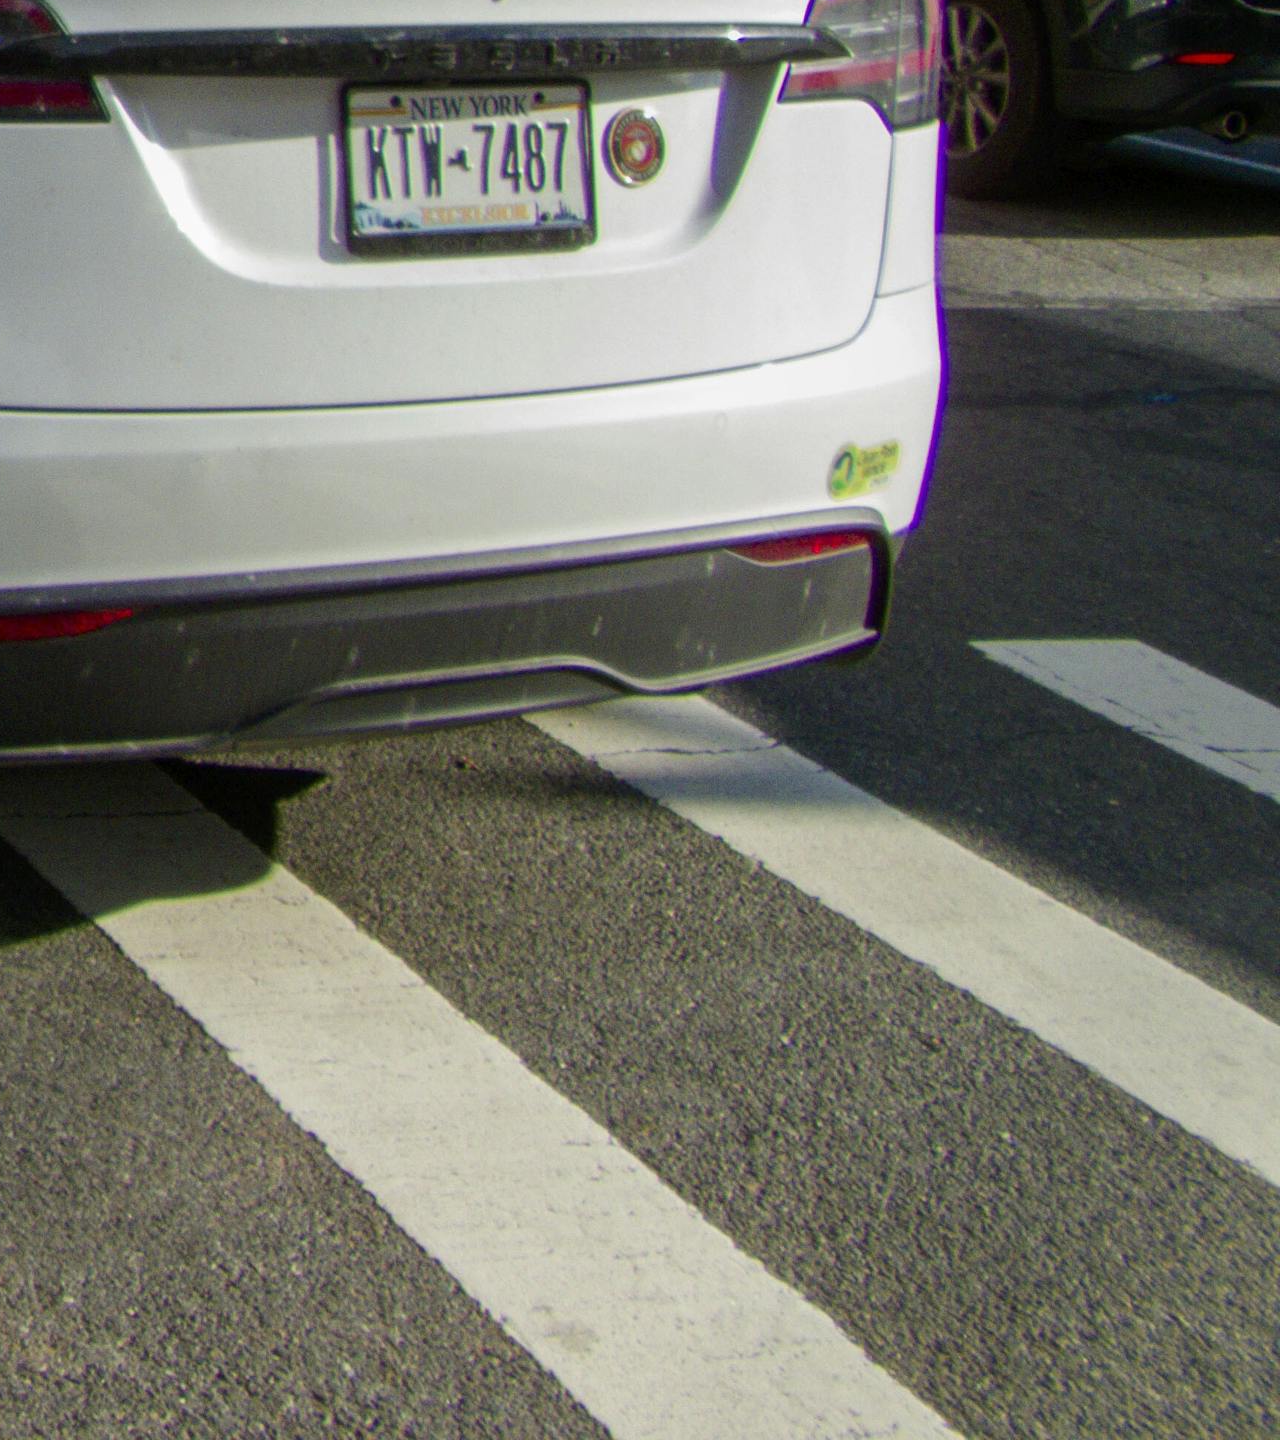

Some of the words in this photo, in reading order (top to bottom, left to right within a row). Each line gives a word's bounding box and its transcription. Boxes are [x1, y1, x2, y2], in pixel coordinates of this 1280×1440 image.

[409, 96, 464, 120] NEW
[469, 94, 528, 117] YORK
[420, 204, 531, 226] EXCELSIOR
